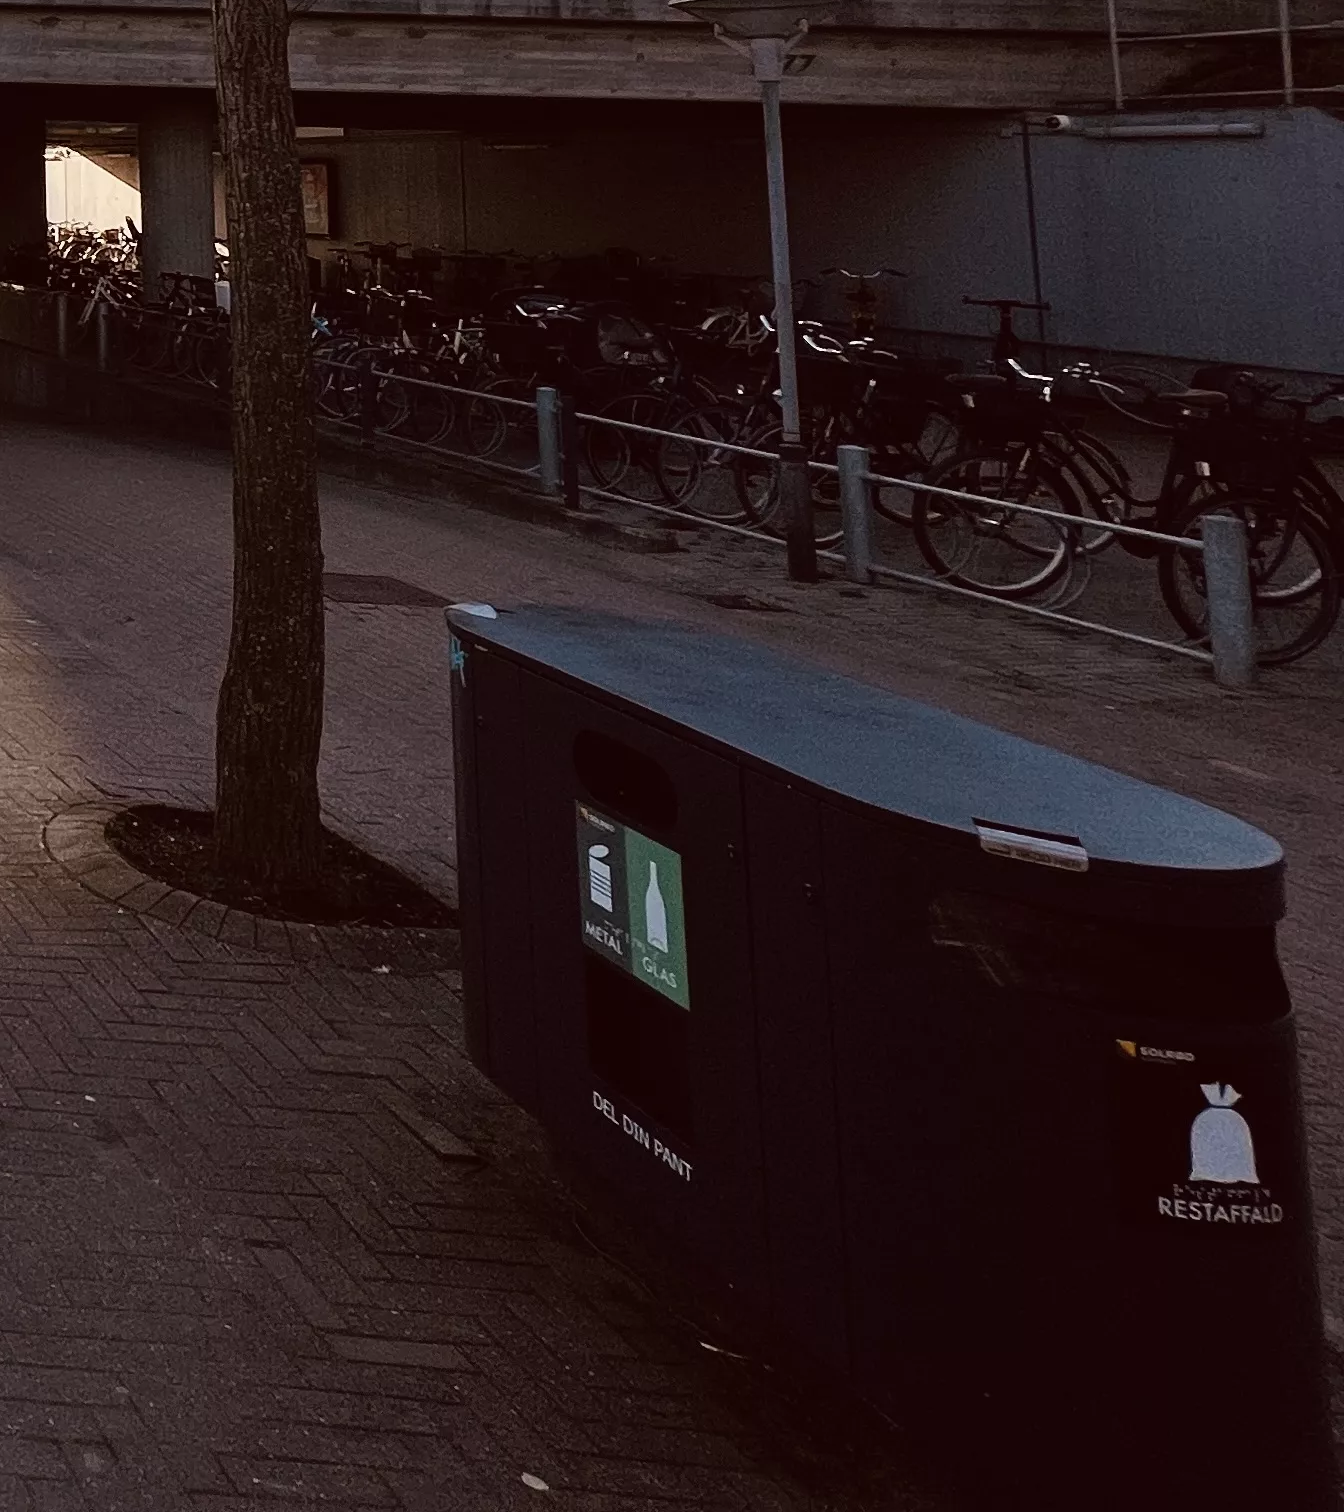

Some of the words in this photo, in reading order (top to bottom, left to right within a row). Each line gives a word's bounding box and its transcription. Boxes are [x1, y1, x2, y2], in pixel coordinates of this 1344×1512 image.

[585, 920, 624, 956] METAL
[642, 956, 678, 990] GLAS
[592, 1090, 620, 1126] DEL
[622, 1113, 650, 1149] DIN
[653, 1138, 693, 1182] PANT
[1158, 1195, 1284, 1224] RESTAFFALD
